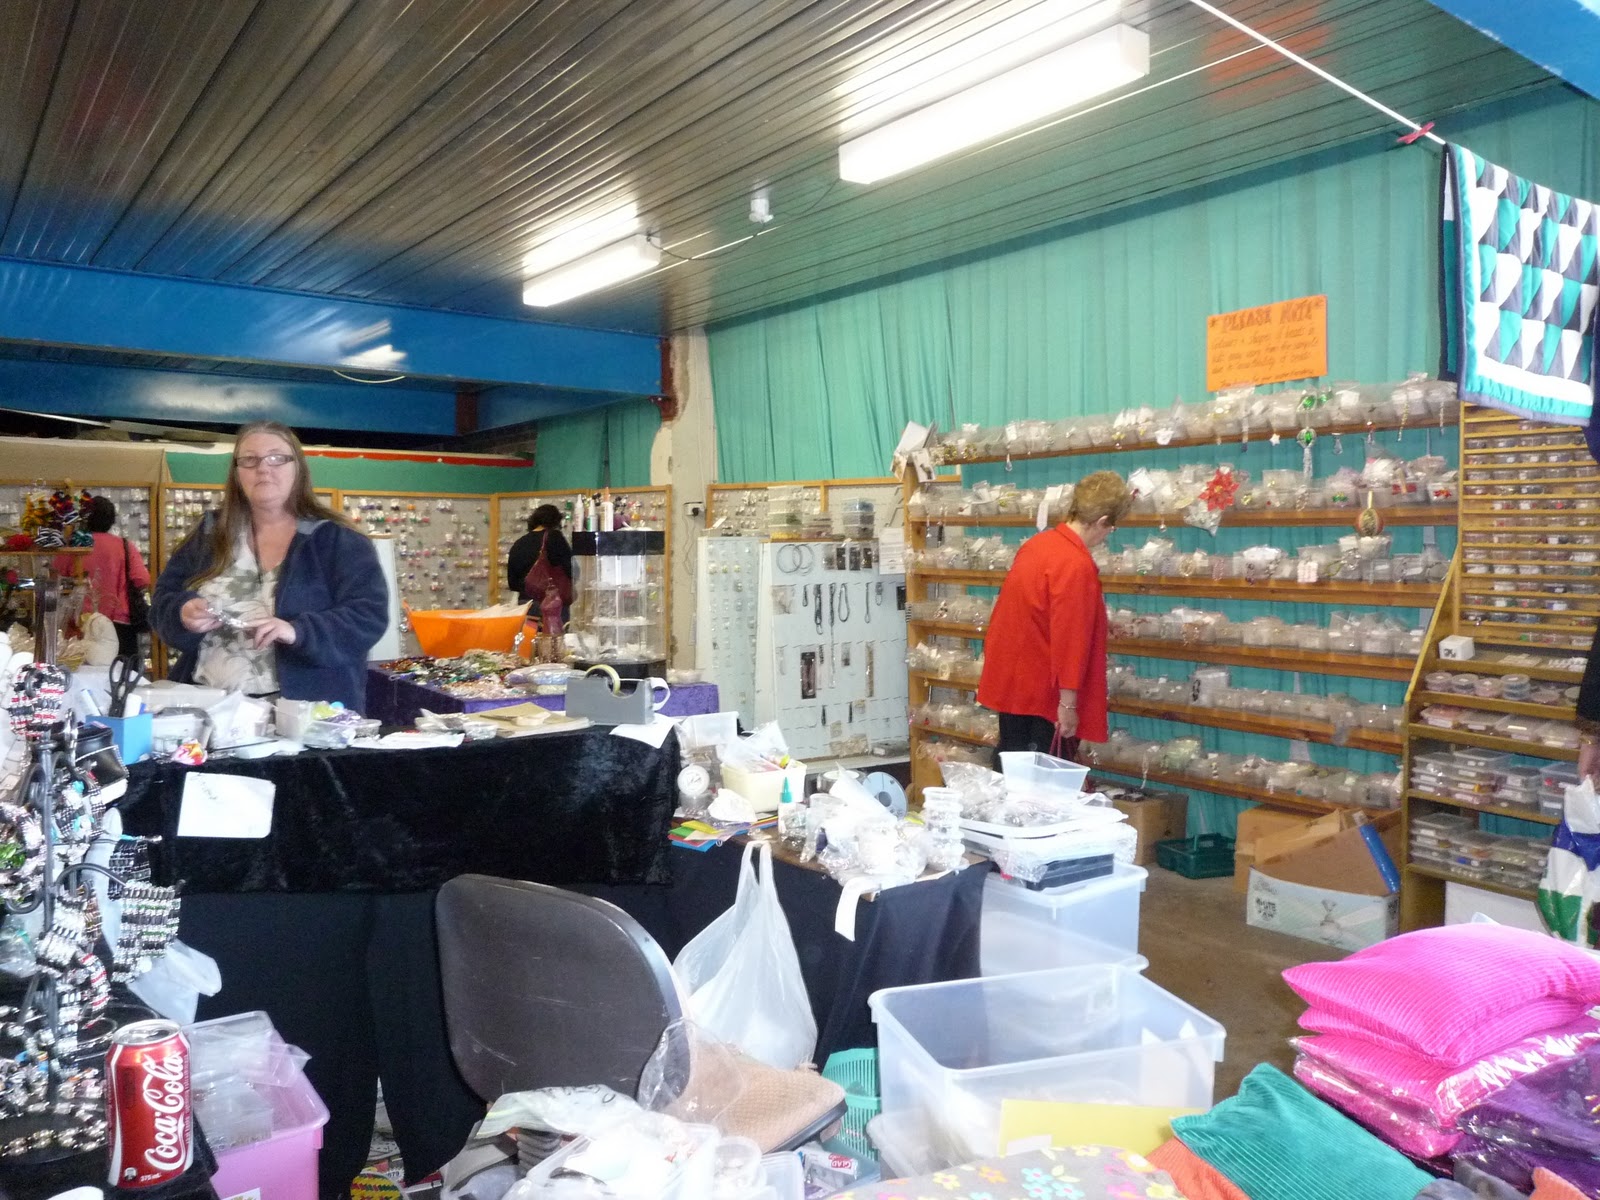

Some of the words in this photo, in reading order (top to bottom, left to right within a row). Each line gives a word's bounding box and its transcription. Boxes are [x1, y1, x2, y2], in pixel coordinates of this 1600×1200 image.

[1222, 305, 1272, 333] PLEASE
[1279, 299, 1312, 324] NOTE
[142, 1053, 184, 1171] Coca-Cola
[831, 1160, 851, 1169] GLAD
